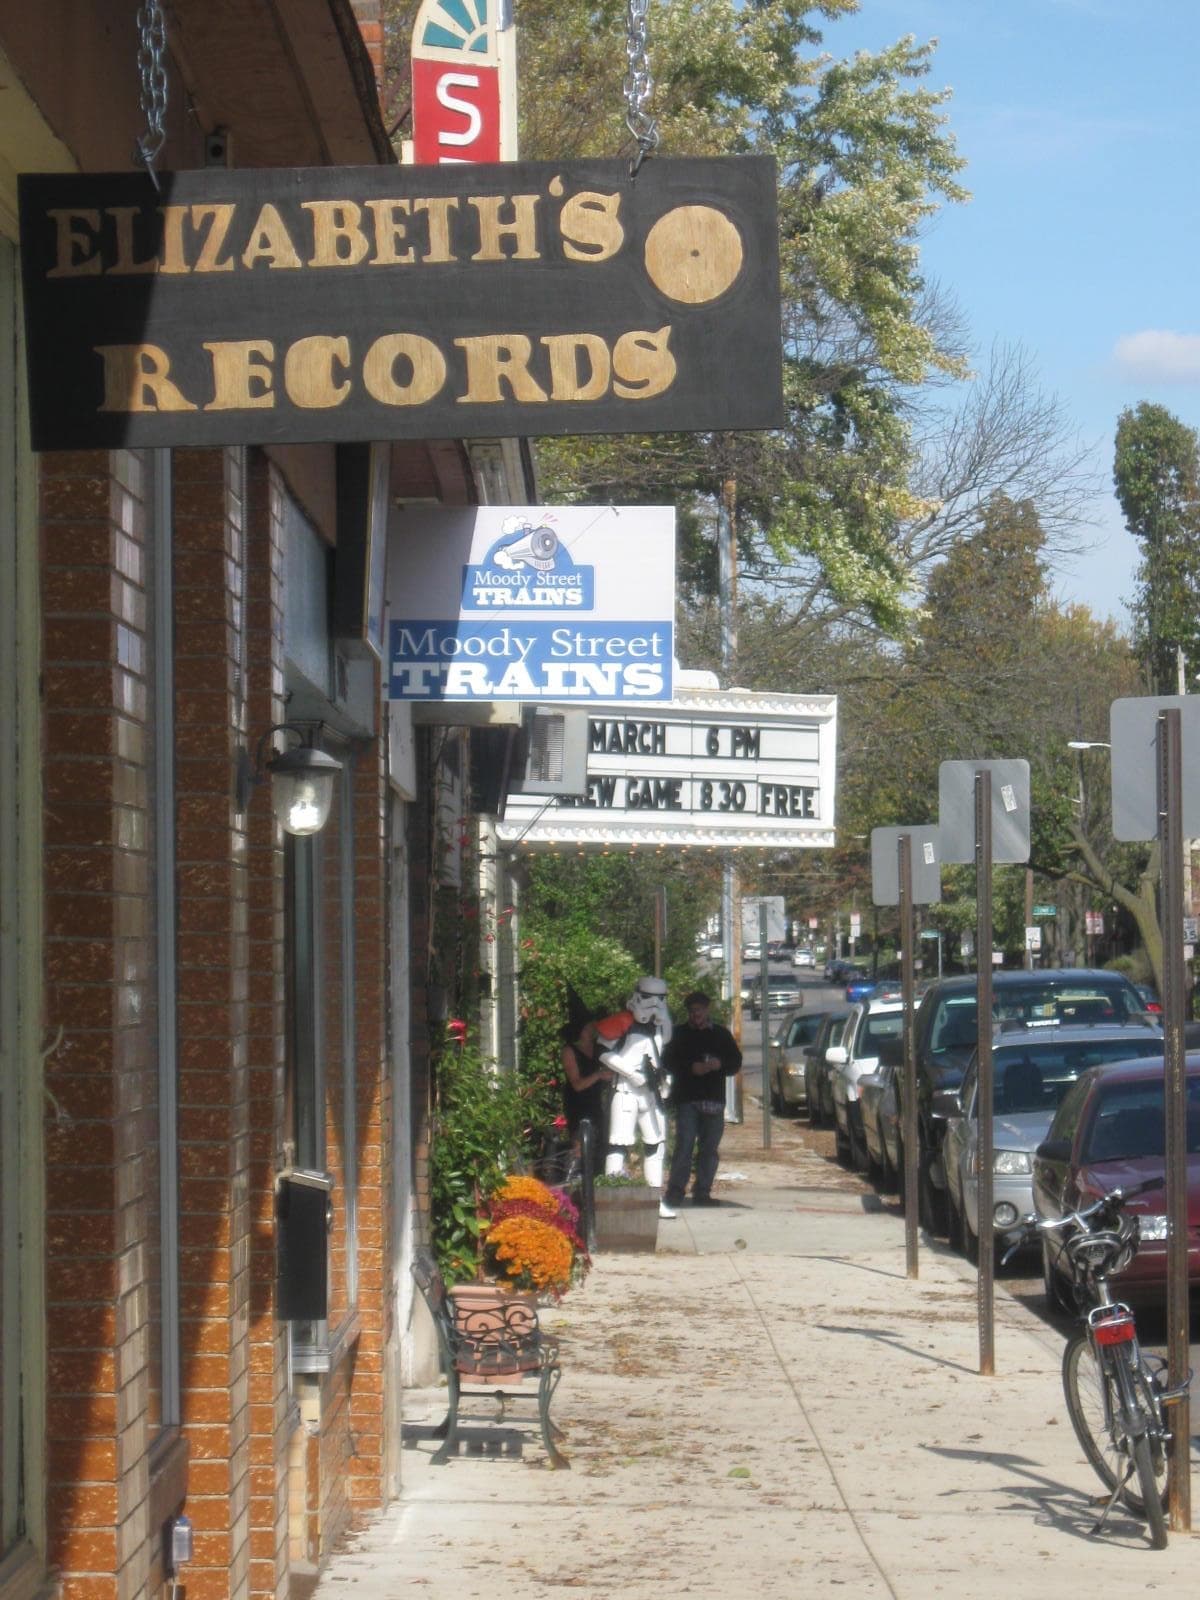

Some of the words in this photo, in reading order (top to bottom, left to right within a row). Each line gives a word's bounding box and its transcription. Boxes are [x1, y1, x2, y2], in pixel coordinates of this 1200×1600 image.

[46, 175, 625, 280] ELIZABETH'S
[94, 325, 678, 412] RECORDS
[472, 588, 583, 606] TRAINS
[474, 571, 531, 587] Moody
[536, 571, 582, 586] Street
[395, 628, 537, 664] Moody
[550, 628, 663, 657] Street
[392, 661, 664, 696] TRAINS
[590, 721, 666, 754] MARCH
[705, 727, 720, 756] 6
[731, 729, 760, 758] PM
[625, 776, 683, 810] GAME
[760, 784, 815, 819] FREE
